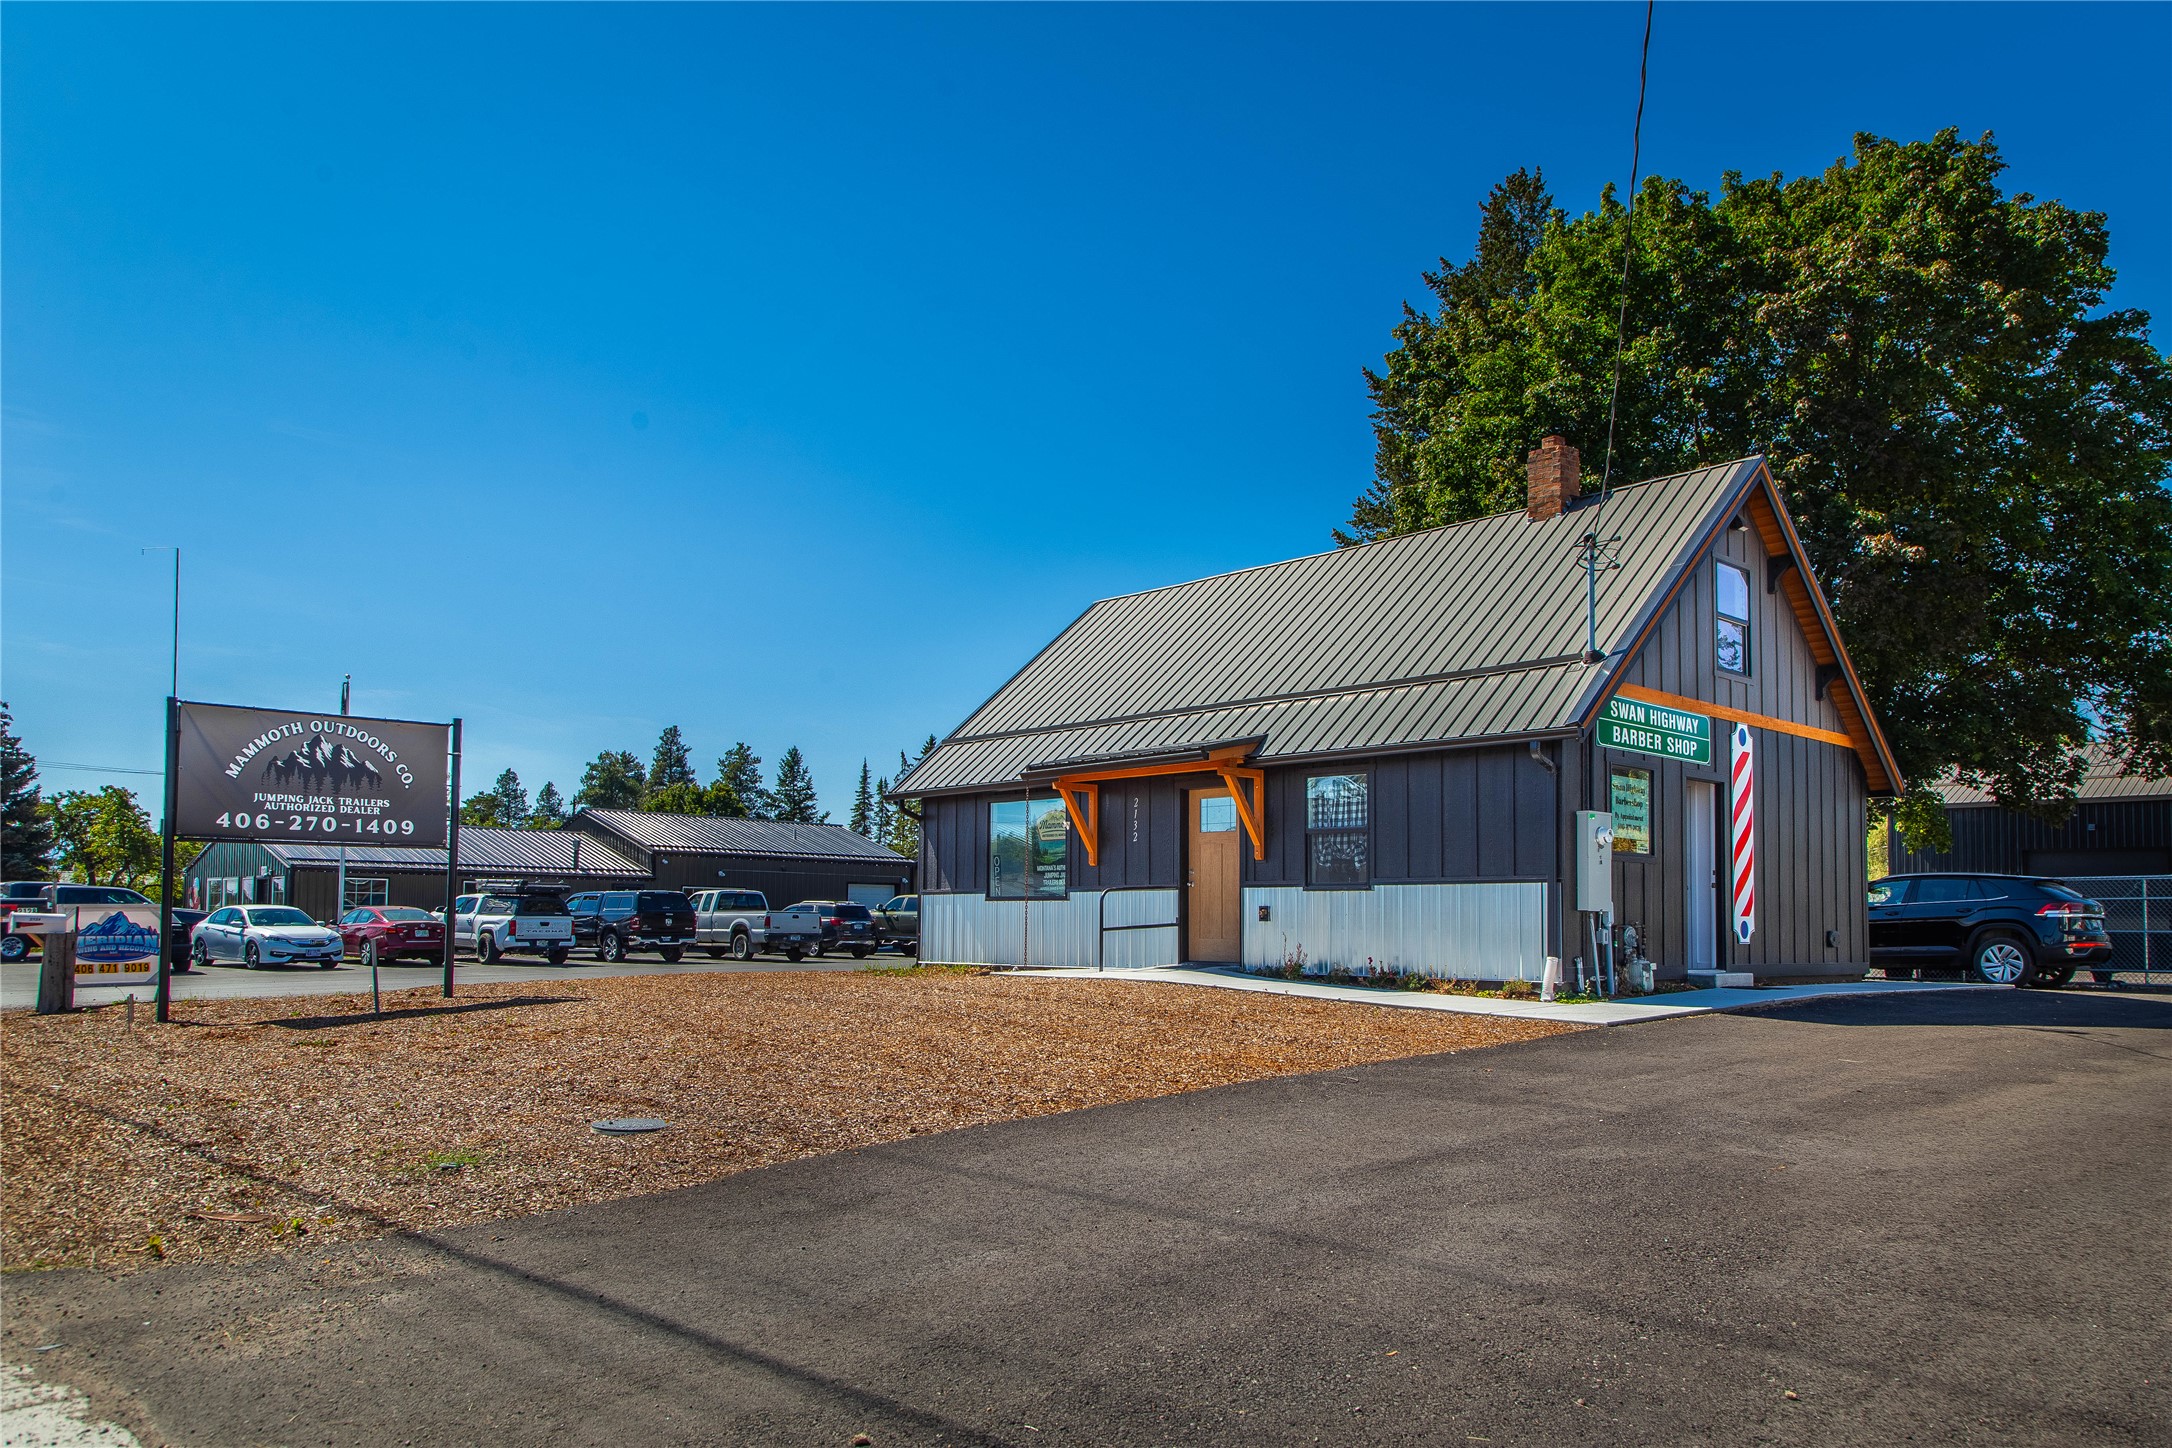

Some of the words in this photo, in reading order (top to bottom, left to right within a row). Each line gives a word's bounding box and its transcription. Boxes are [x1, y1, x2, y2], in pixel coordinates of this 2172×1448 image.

[1610, 700, 1645, 723] SWAN
[1649, 709, 1699, 734] HIGHWAY
[1613, 725, 1662, 750] BARBER
[1666, 737, 1697, 756] SHOP
[224, 721, 304, 779] MAMMOTH
[309, 720, 398, 763] OUTDOORS
[395, 763, 414, 789] CO.
[253, 792, 304, 804] JUMPING
[308, 795, 334, 805] JACK
[338, 797, 391, 808] TRAILERS
[264, 801, 335, 813] AUTHORIZED
[340, 805, 381, 815] DEALER
[1615, 796, 1643, 810] Barbershop
[215, 811, 415, 835] 406-270-1409
[993, 856, 1001, 896] OPEN
[119, 945, 160, 954] RECOVERY
[75, 965, 94, 973] 406
[99, 964, 118, 973] 471
[124, 963, 150, 972] 9019
